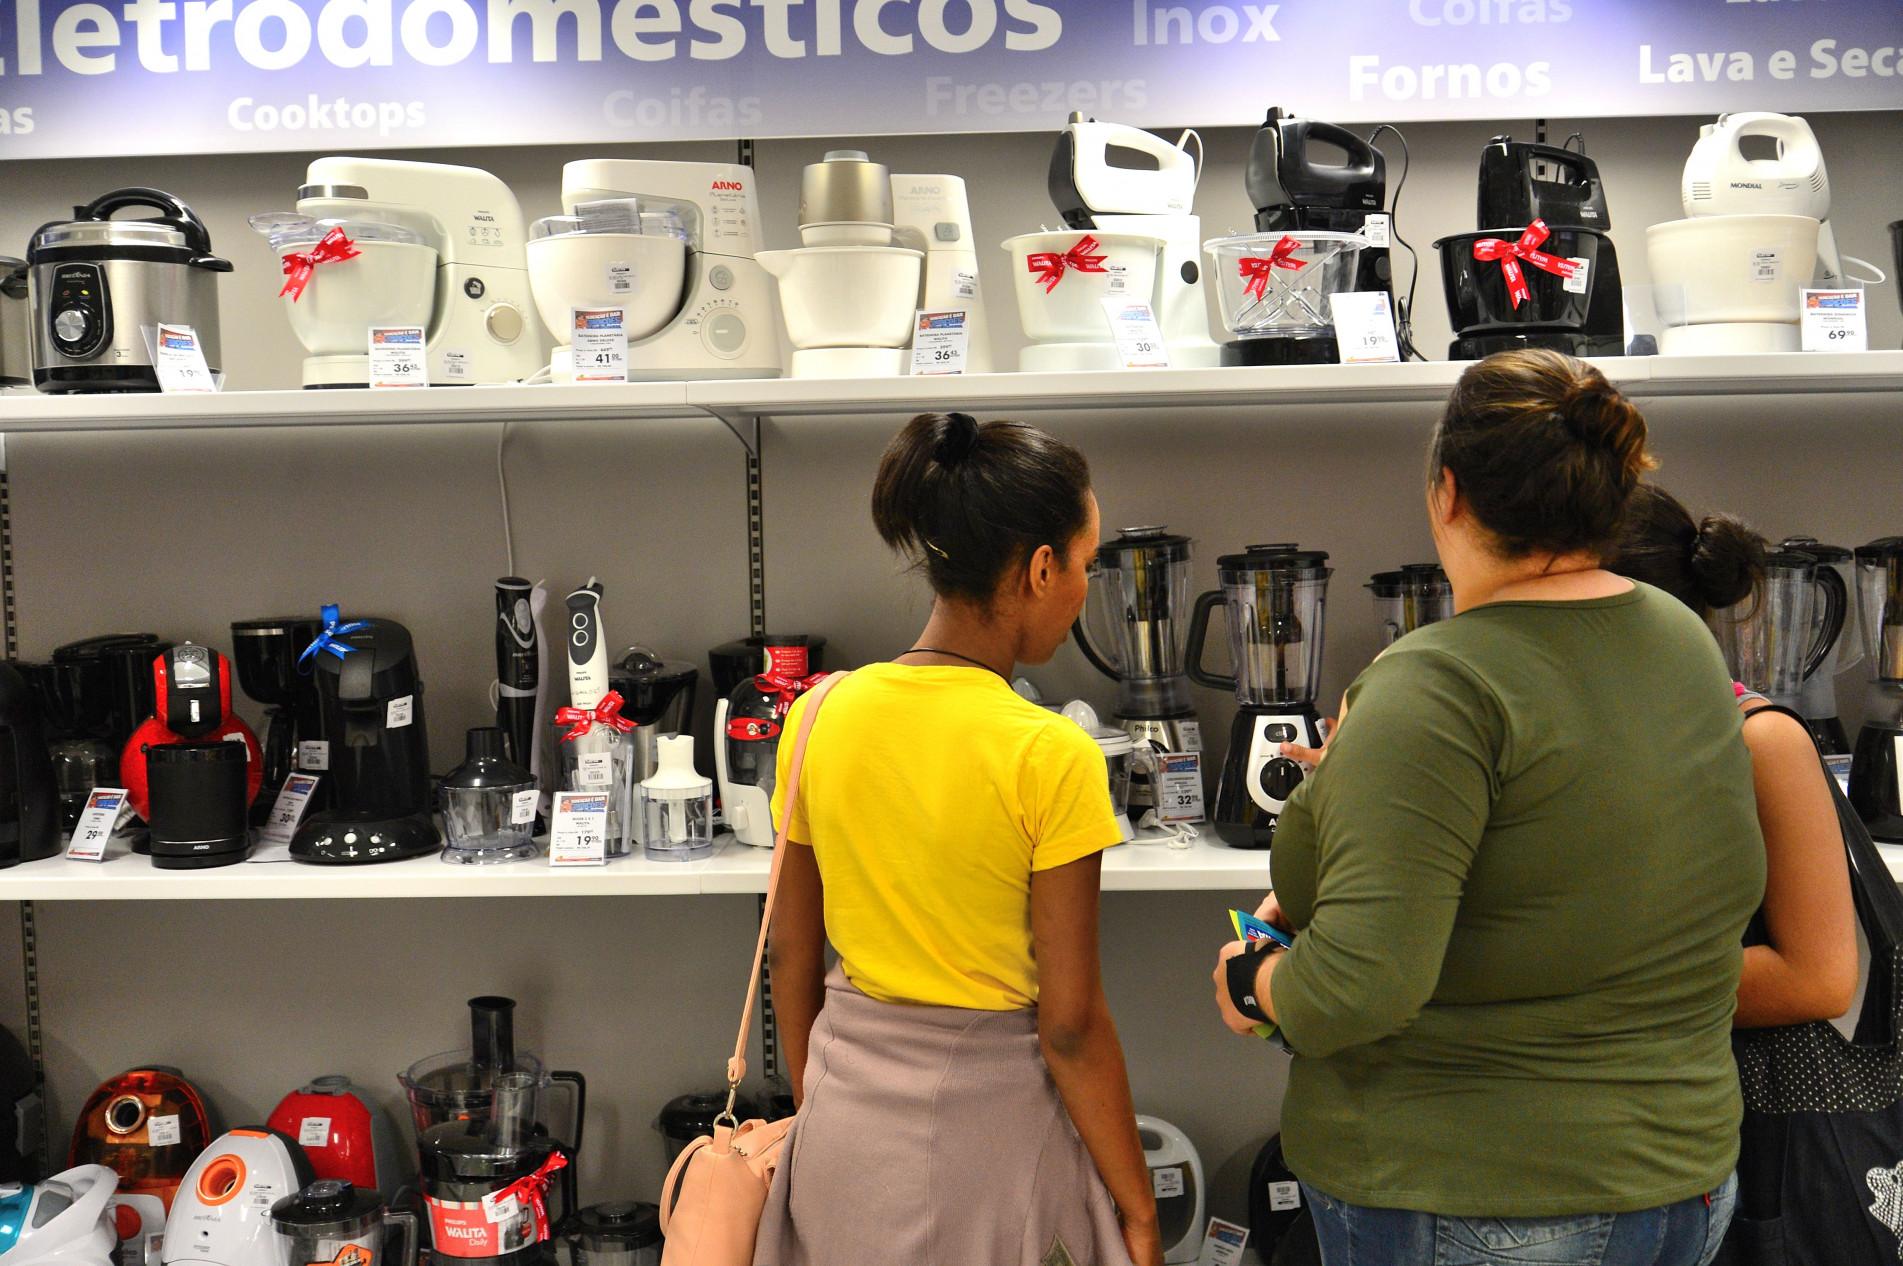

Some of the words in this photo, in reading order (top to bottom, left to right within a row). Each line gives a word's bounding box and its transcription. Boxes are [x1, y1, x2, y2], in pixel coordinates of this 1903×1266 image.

[1132, 0, 1282, 46] Inox
[1639, 44, 1754, 83] Lava
[1768, 49, 1797, 80] e
[1809, 38, 1903, 79] Sec
[1349, 54, 1552, 102] Fornos
[924, 75, 1148, 116] Freezers
[602, 85, 763, 130] Coifas
[227, 95, 426, 138] Cooktops
[711, 180, 743, 192] ARNO
[910, 186, 941, 195] ARNO
[1730, 182, 1763, 190] MONDIAL
[473, 214, 495, 222] WALITA
[1828, 330, 1846, 340] 69
[1363, 336, 1377, 346] 19
[1136, 342, 1151, 352] 30
[595, 353, 610, 363] 41
[934, 350, 950, 361] 36
[393, 363, 410, 373] 36
[1134, 724, 1159, 733] Philco
[1177, 795, 1191, 805] 32
[85, 830, 98, 840] 29
[577, 836, 591, 845] 19
[444, 1218, 467, 1226] PHILIPS
[444, 1226, 488, 1239] WALITA
[469, 1238, 488, 1247] Daily
